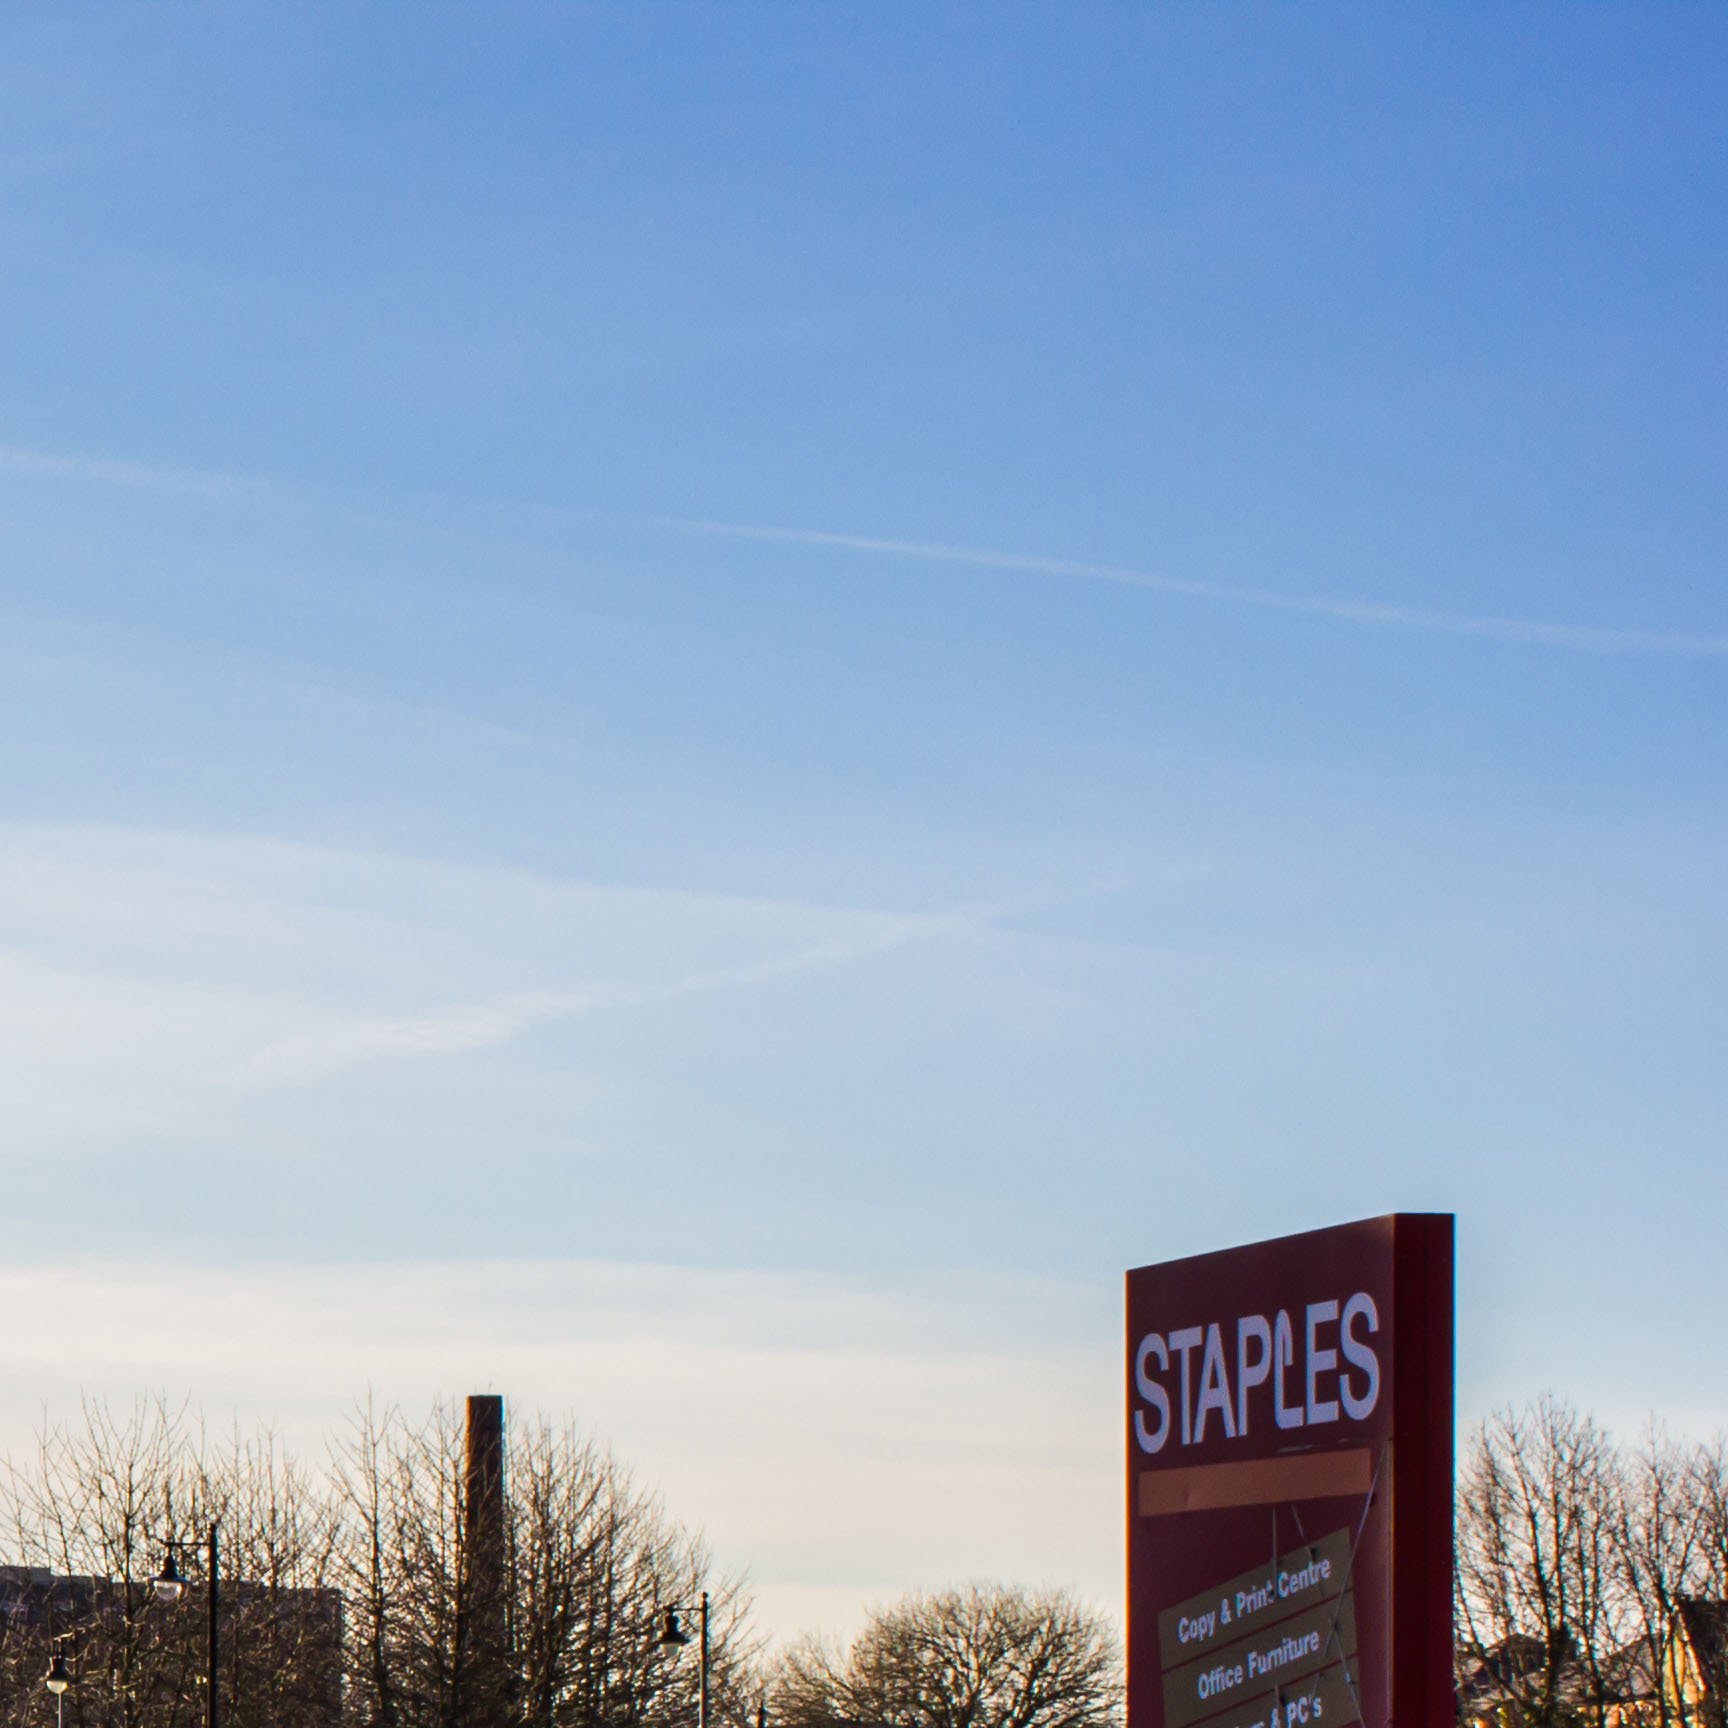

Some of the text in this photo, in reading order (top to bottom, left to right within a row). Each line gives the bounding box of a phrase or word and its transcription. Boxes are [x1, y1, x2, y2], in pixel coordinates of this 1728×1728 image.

[1134, 1292, 1380, 1454] STAPLES
[1178, 1558, 1331, 1644] Copy & Print Centre
[1197, 1631, 1319, 1700] Office Furniture
[1286, 1696, 1322, 1728] PC's
